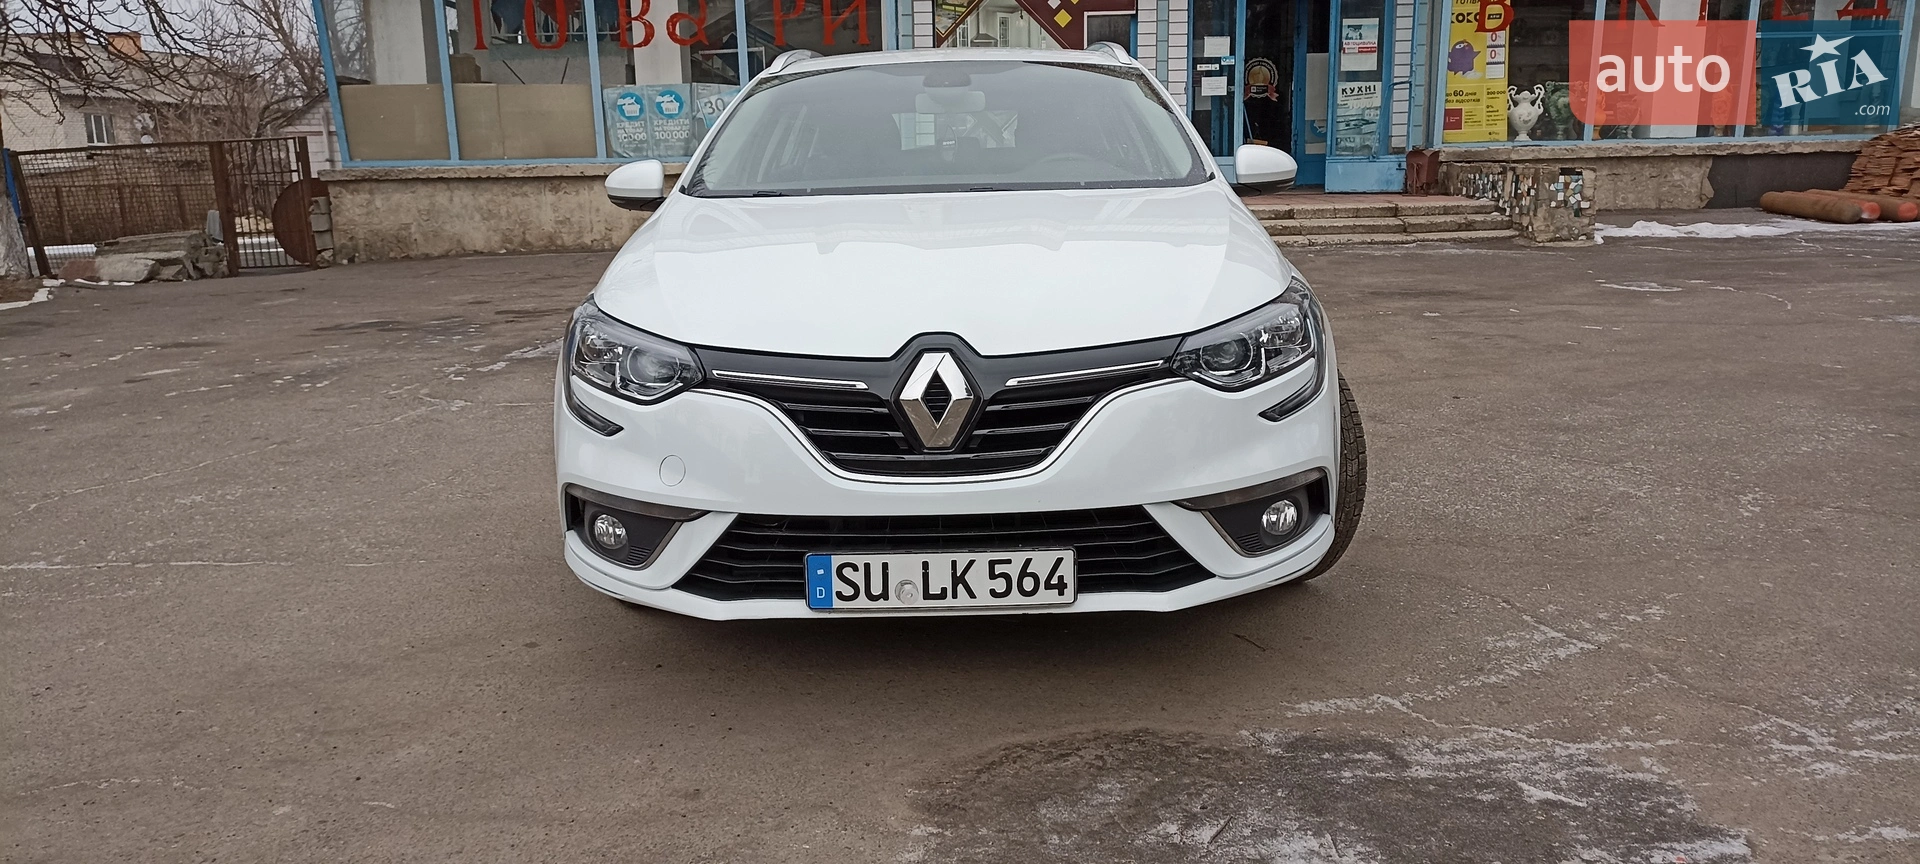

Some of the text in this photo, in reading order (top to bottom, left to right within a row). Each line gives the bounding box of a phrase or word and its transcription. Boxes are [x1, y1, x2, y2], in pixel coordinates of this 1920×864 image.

[1341, 84, 1377, 96] КУХНІ
[1453, 89, 1464, 97] 60
[703, 96, 726, 116] 30
[654, 130, 690, 140] 100 000
[835, 556, 1069, 603] SU LK 564
[816, 587, 826, 599] D
